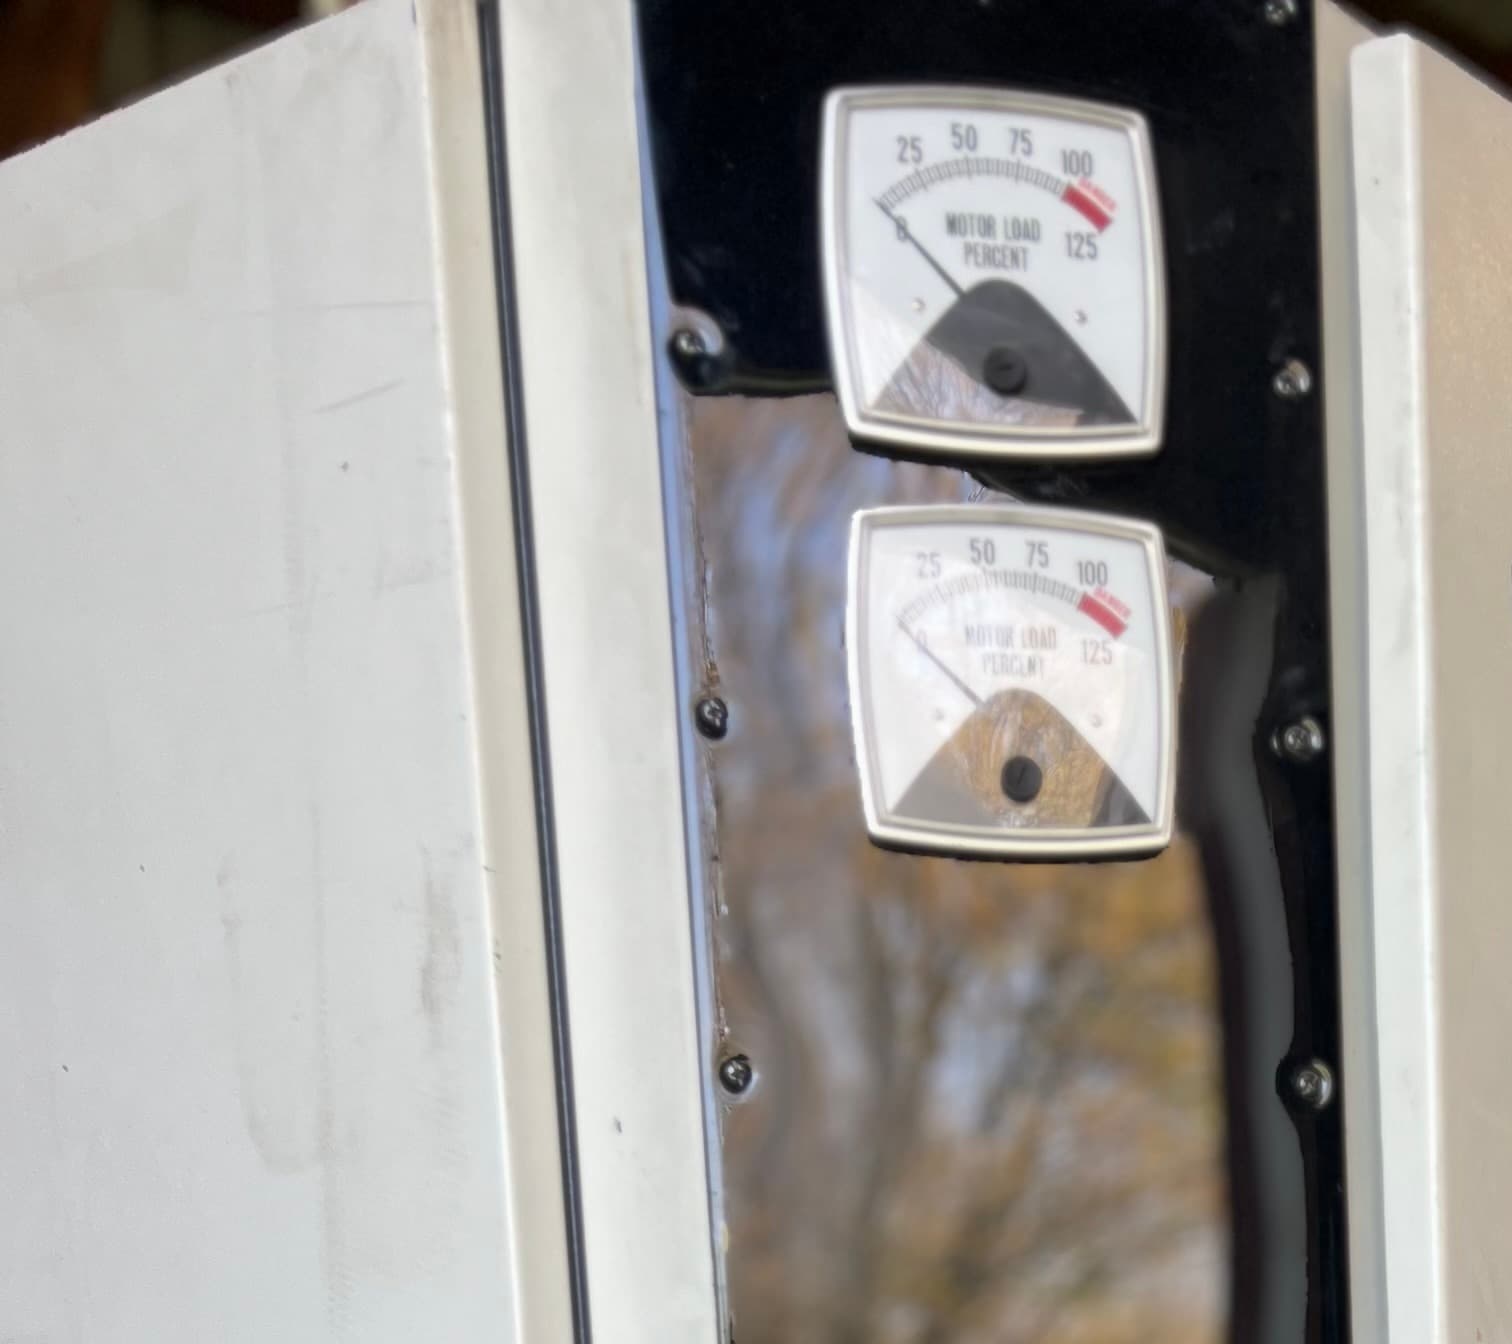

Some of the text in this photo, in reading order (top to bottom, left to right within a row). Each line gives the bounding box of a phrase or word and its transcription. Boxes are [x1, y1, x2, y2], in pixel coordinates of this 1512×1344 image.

[897, 136, 923, 163] 25
[950, 123, 978, 152] 50
[1008, 129, 1033, 156] 75
[1061, 150, 1092, 176] 100
[945, 212, 1041, 241] MOTOR LOAD
[963, 242, 1029, 271] PERCENT
[1065, 231, 1098, 260] 125
[917, 552, 941, 579] 25
[969, 538, 996, 566] 50
[1025, 540, 1049, 568] 75
[1078, 561, 1108, 586] 100
[964, 625, 1057, 650] MOTOR LOAD
[1080, 638, 1113, 666] 125
